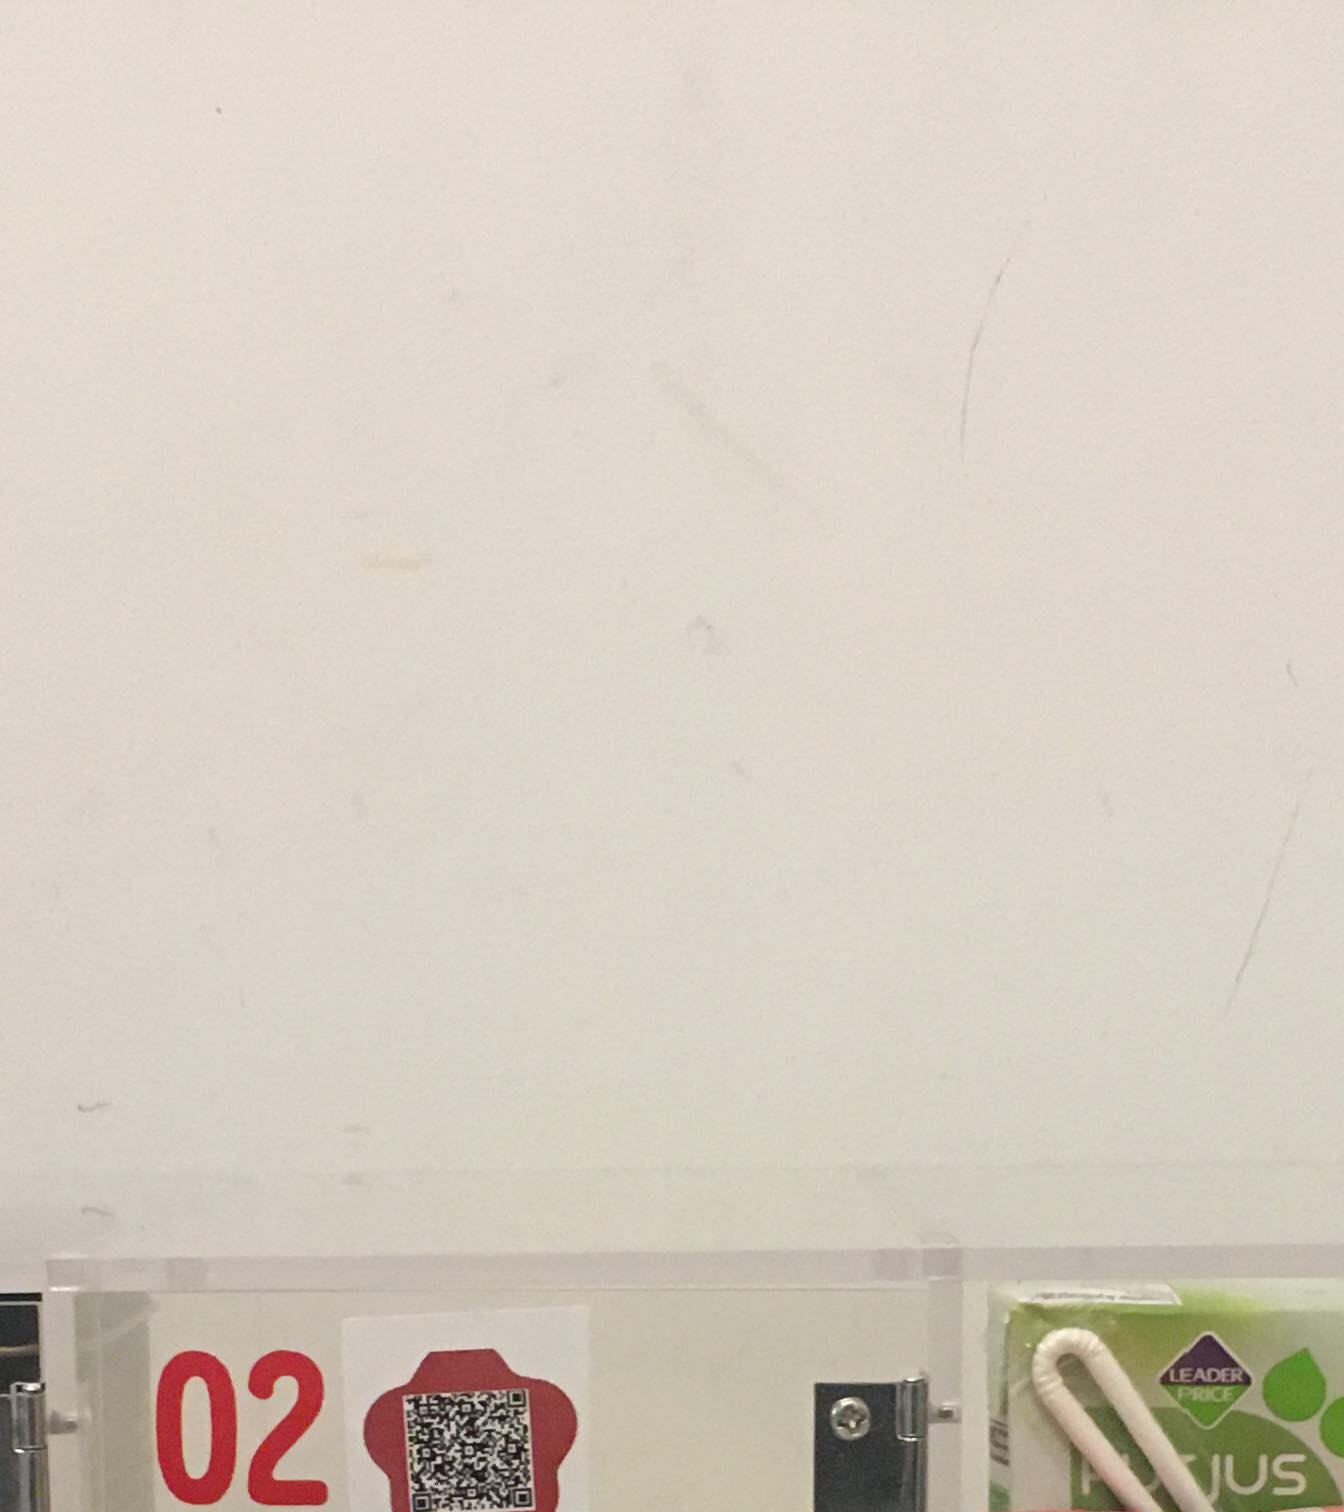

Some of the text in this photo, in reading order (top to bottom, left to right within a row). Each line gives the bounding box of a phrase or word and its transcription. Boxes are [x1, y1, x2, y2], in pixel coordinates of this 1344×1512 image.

[1169, 1367, 1244, 1383] LEADER
[1176, 1385, 1234, 1401] PRICE
[156, 1350, 328, 1506] 02
